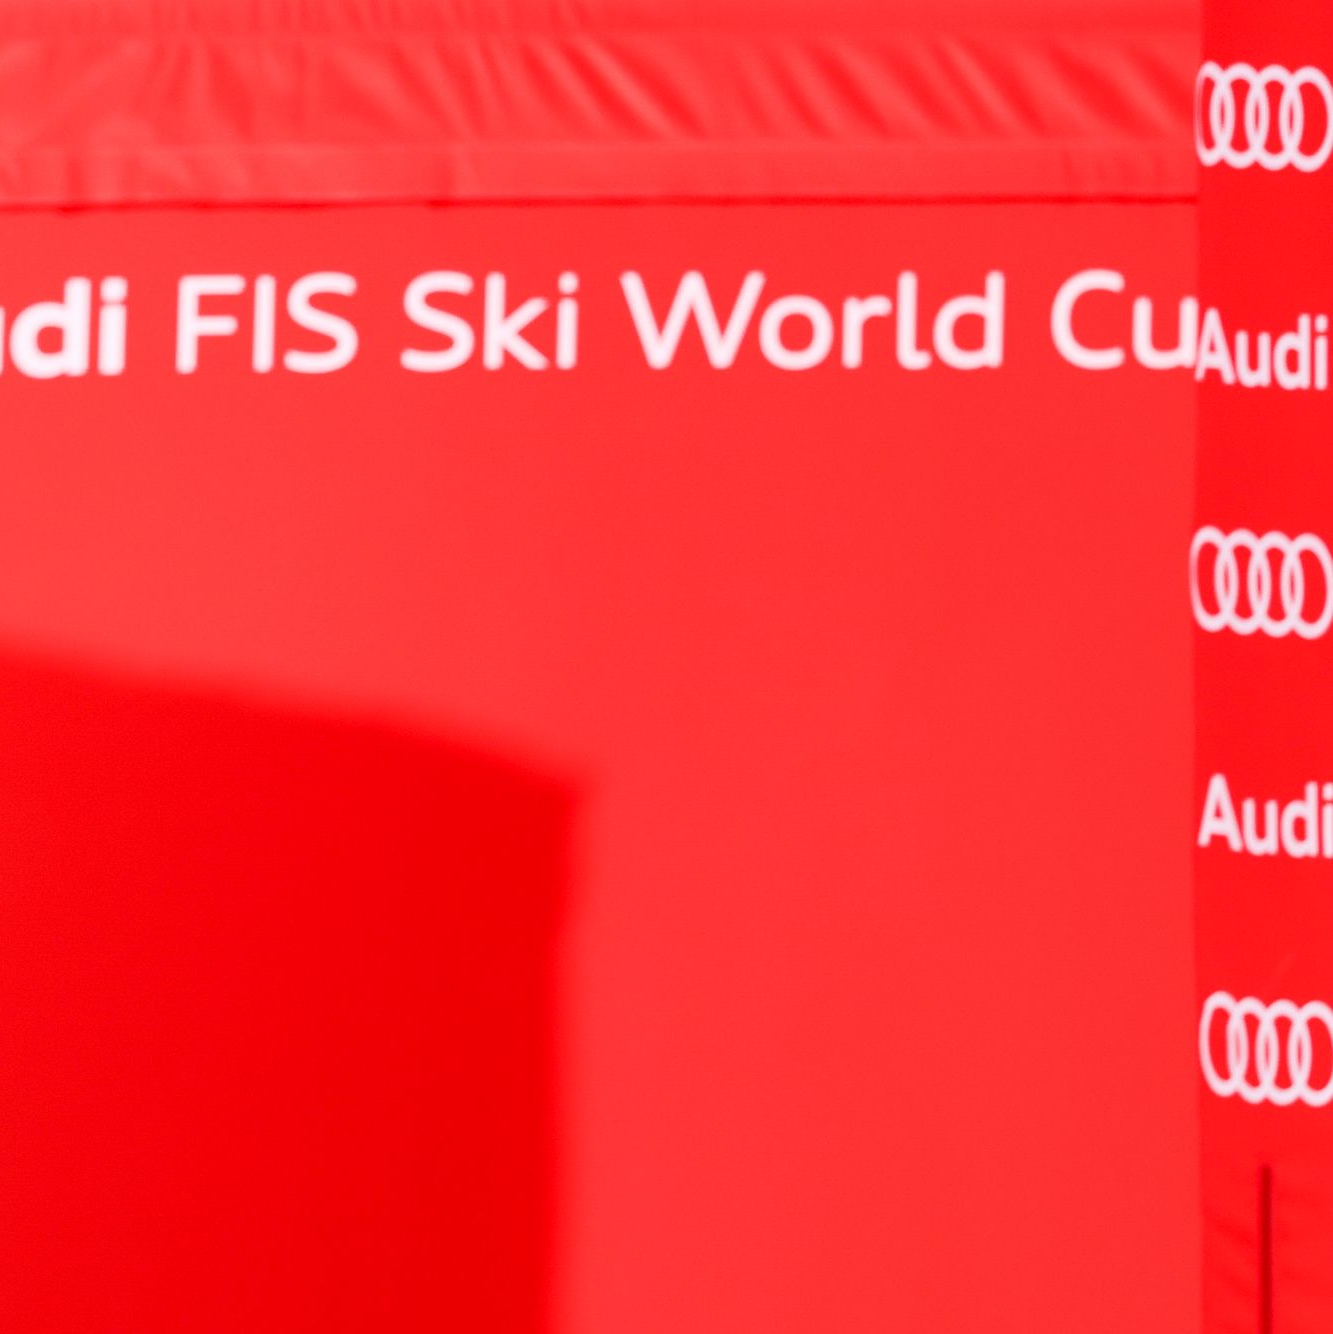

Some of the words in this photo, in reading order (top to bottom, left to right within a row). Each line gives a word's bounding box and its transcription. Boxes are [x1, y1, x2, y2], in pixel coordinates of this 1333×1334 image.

[174, 272, 360, 375] FIS
[398, 270, 580, 373] Ski
[619, 270, 1006, 371] World
[1194, 307, 1329, 391] Audi
[1196, 772, 1333, 859] Audi
